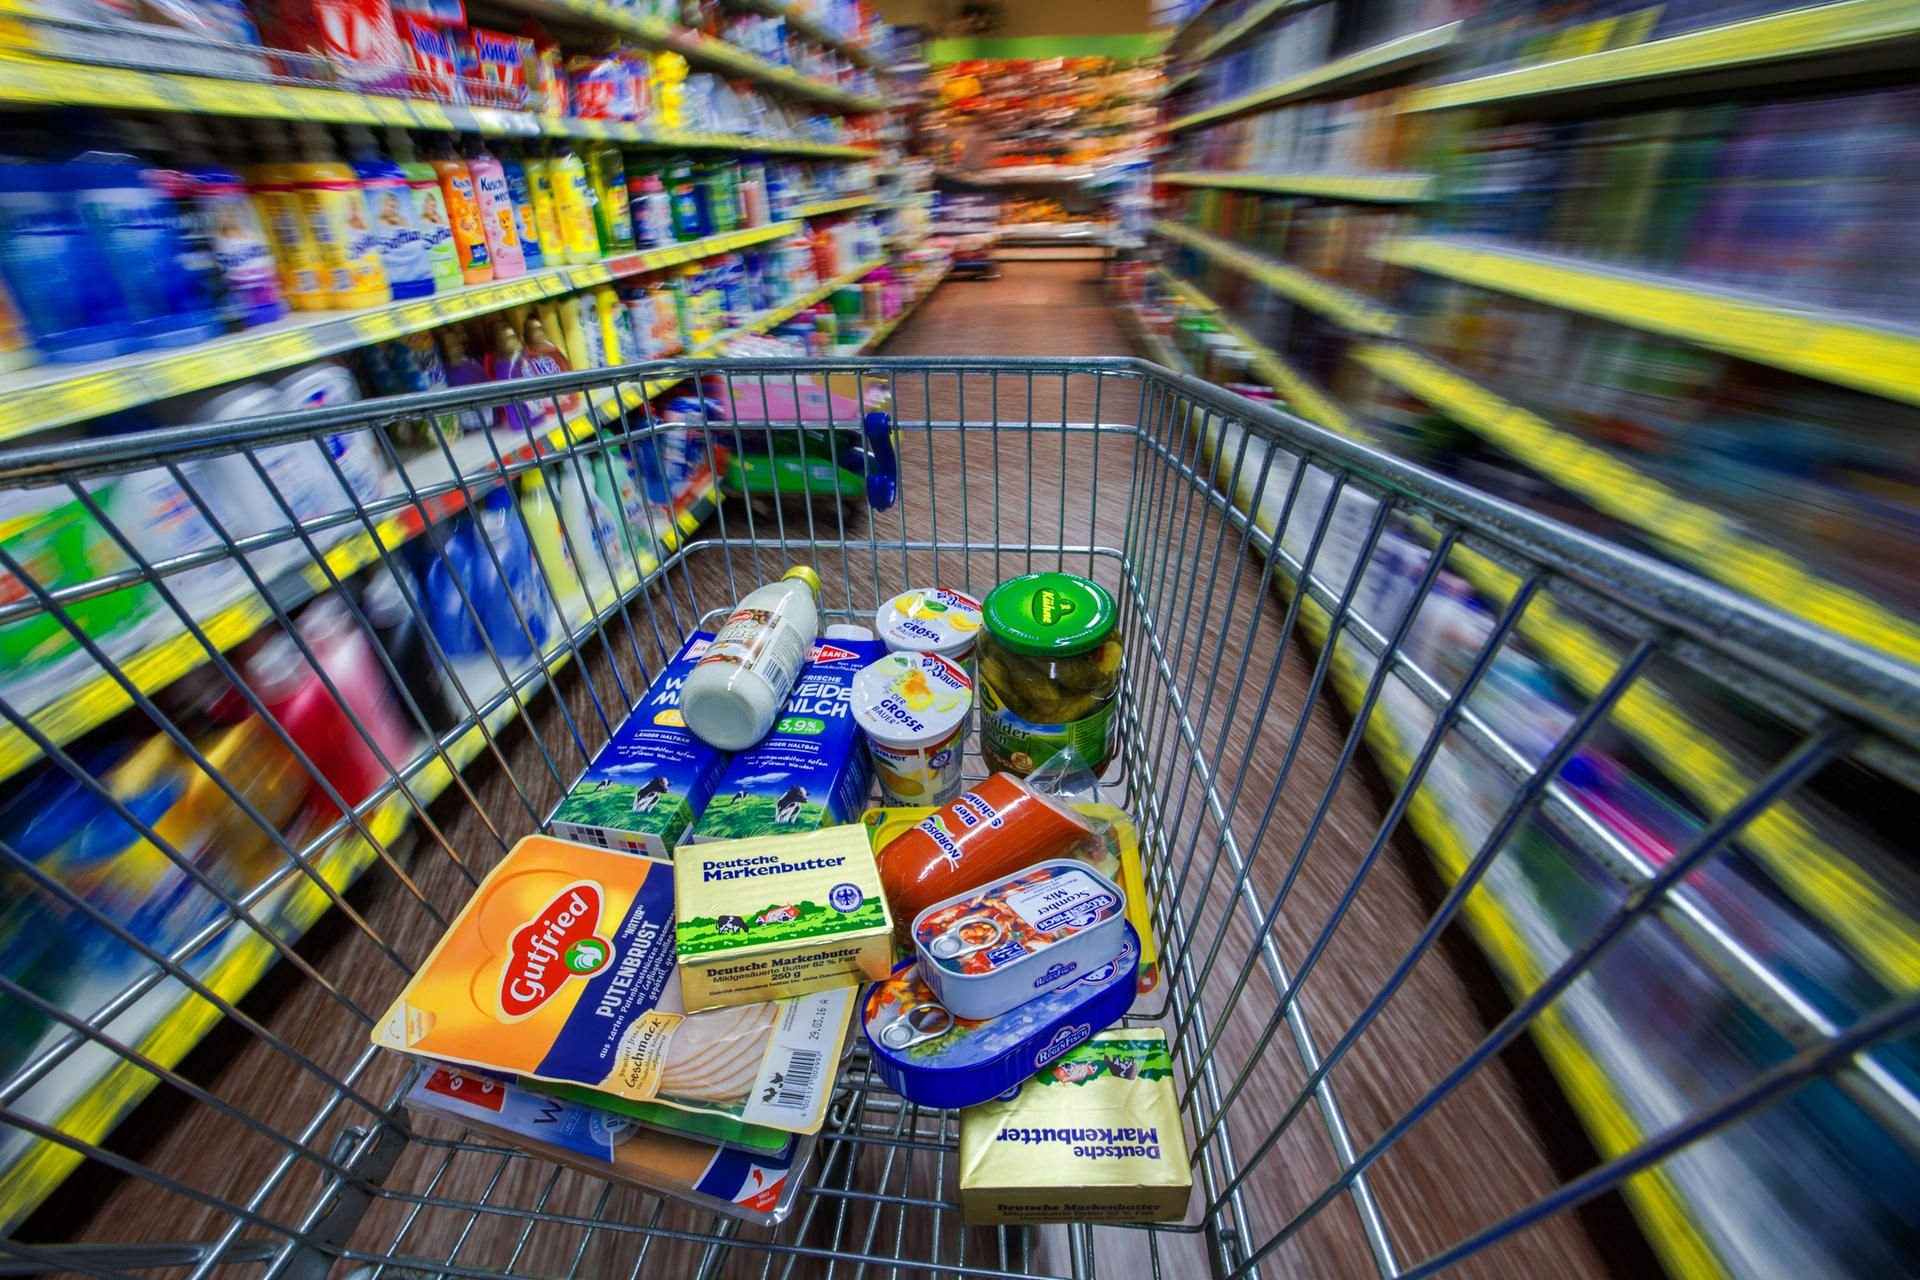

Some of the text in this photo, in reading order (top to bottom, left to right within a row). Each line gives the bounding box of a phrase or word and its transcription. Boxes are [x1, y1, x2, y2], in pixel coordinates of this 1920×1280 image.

[1042, 590, 1055, 624] Kühne
[927, 661, 964, 690] Bauer
[890, 693, 907, 706] DER
[880, 699, 925, 733] GROSSE
[953, 805, 978, 827] Bier
[702, 855, 779, 871] Deutsche
[703, 855, 847, 883] Markenbutter
[1038, 890, 1091, 916] Scomber
[1042, 888, 1068, 903] Mix
[509, 891, 590, 1004] Gutfried
[595, 920, 661, 1019] PUTENBRUST
[706, 947, 863, 978] Deutsche Markenbutter
[771, 971, 792, 981] 250
[600, 1043, 611, 1059] aus
[608, 1014, 625, 1042] zarten
[620, 946, 659, 1014] Putenbruststücken
[635, 991, 647, 1006] mit
[624, 1017, 662, 1089] Geschmack
[995, 1127, 1159, 1144] Markenbutter
[1073, 1145, 1161, 1160] Deutsche
[1063, 1203, 1163, 1211] Markenbutter
